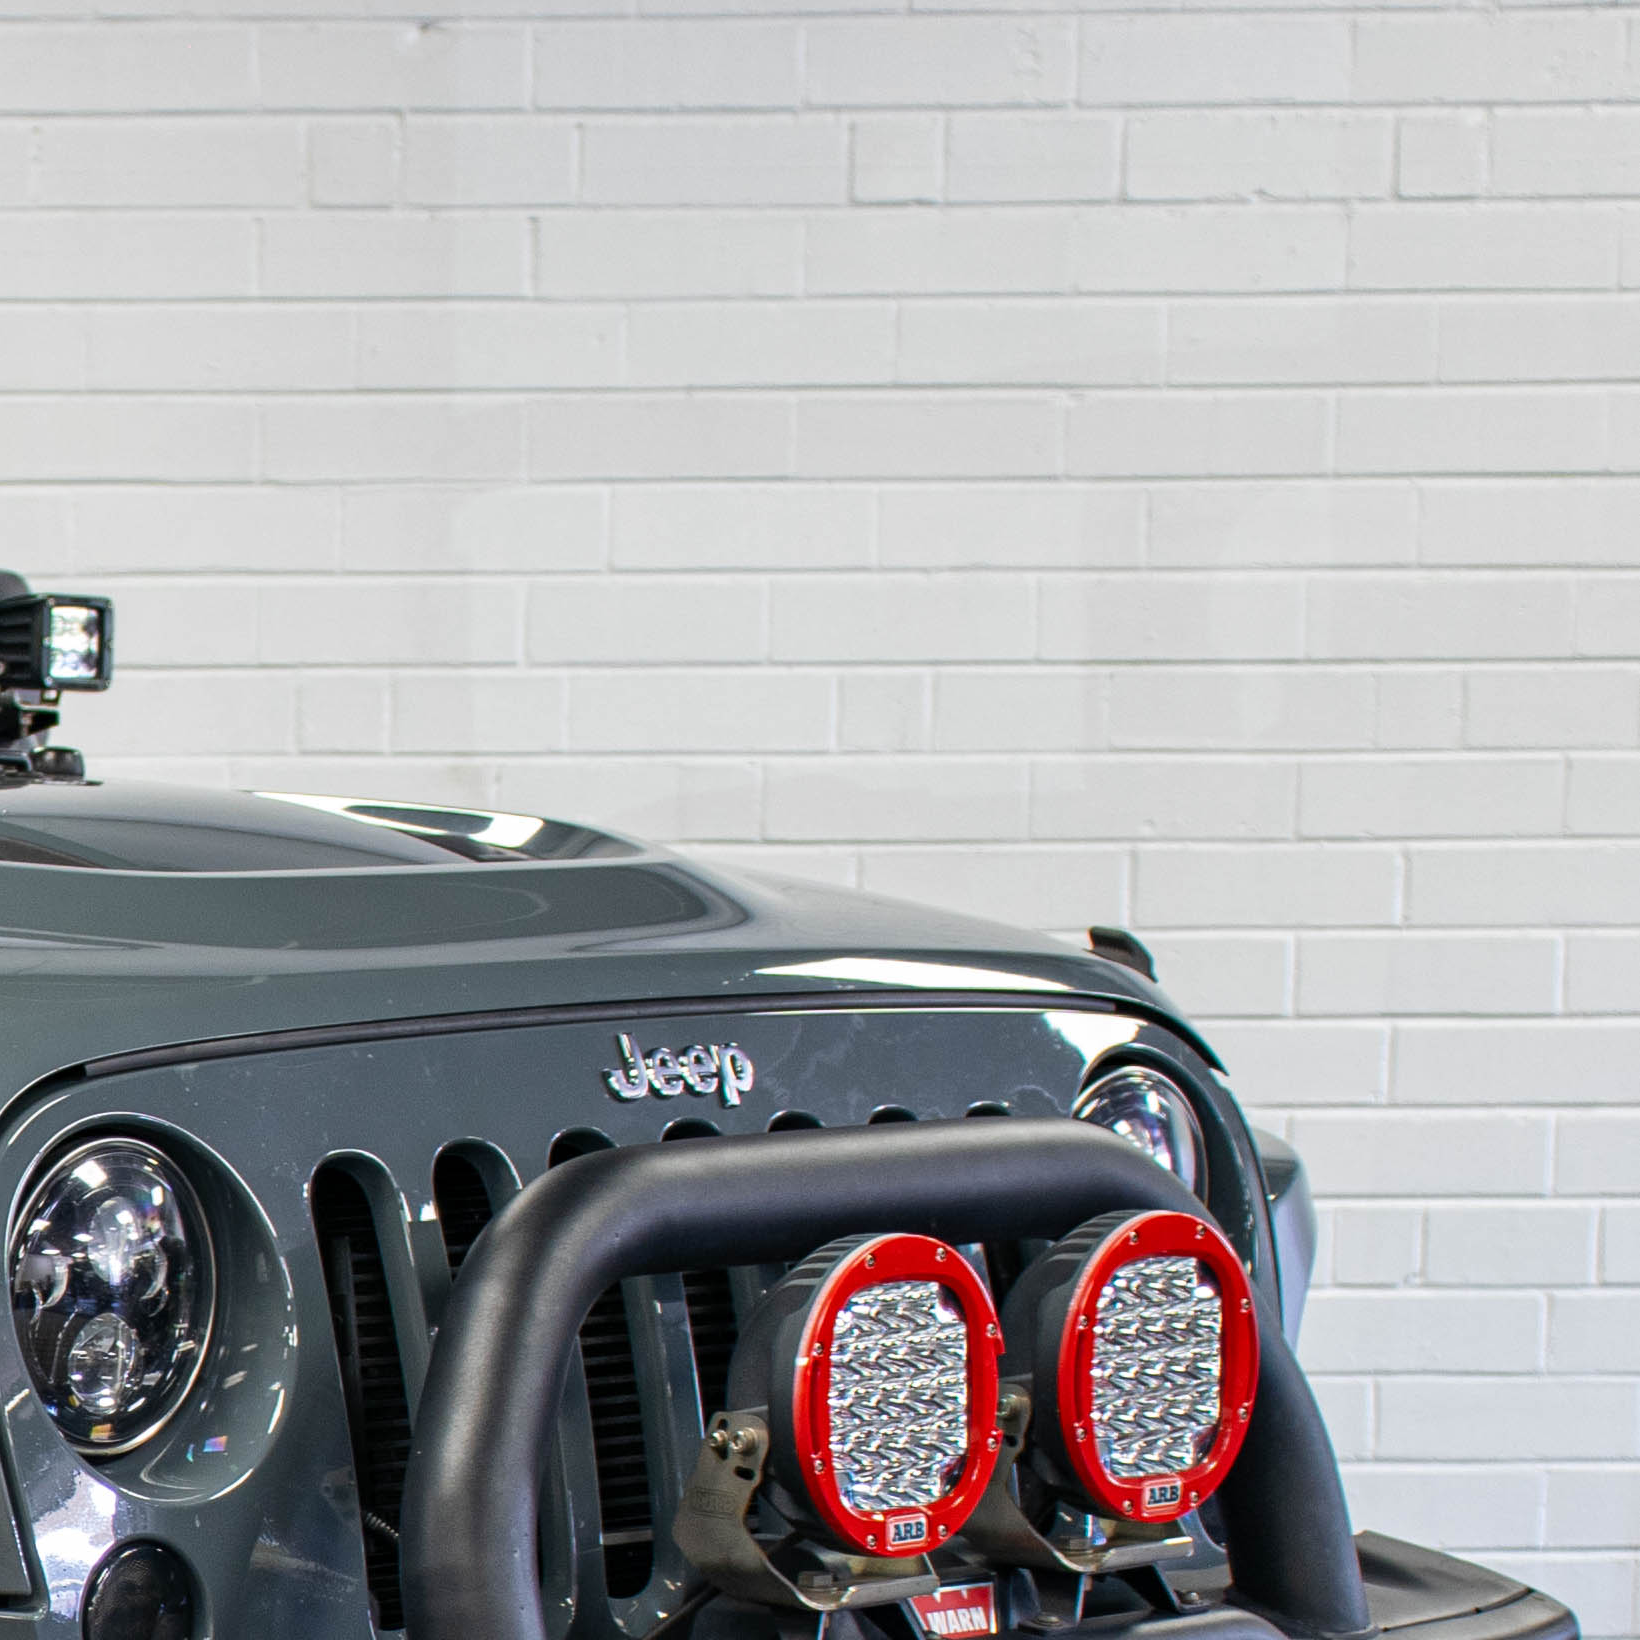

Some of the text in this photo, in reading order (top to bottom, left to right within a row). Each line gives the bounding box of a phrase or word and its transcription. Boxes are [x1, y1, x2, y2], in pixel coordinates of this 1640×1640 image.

[601, 1032, 754, 1109] Jeep
[1147, 1485, 1180, 1505] ARB
[892, 1521, 925, 1542] ARB
[926, 1606, 988, 1636] WARN
